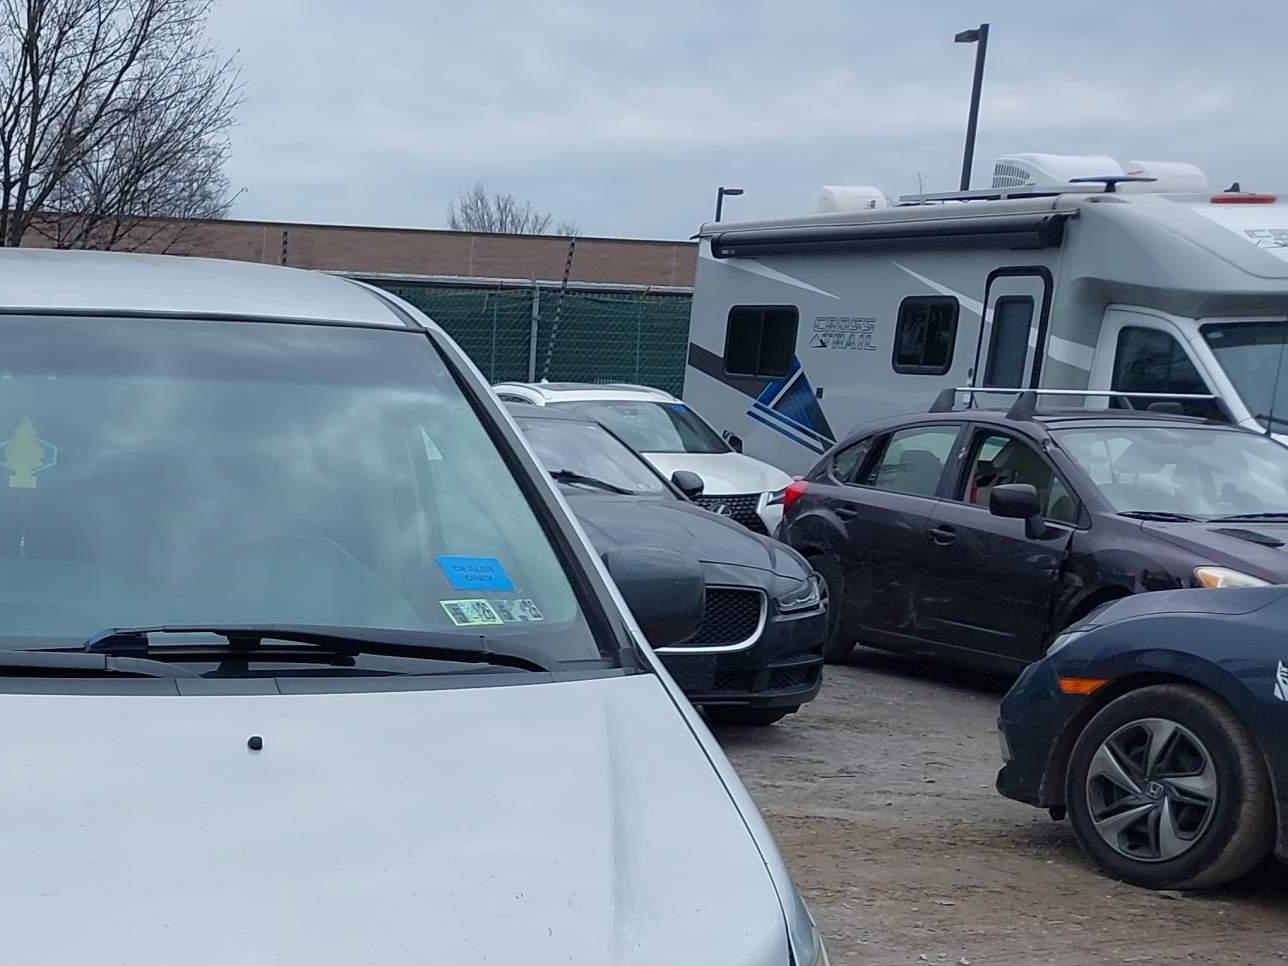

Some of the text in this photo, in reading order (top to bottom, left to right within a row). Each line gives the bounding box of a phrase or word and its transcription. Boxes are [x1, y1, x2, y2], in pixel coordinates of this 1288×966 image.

[813, 316, 877, 334] CROSS
[821, 333, 878, 351] TRAIL
[452, 564, 495, 573] DEALER
